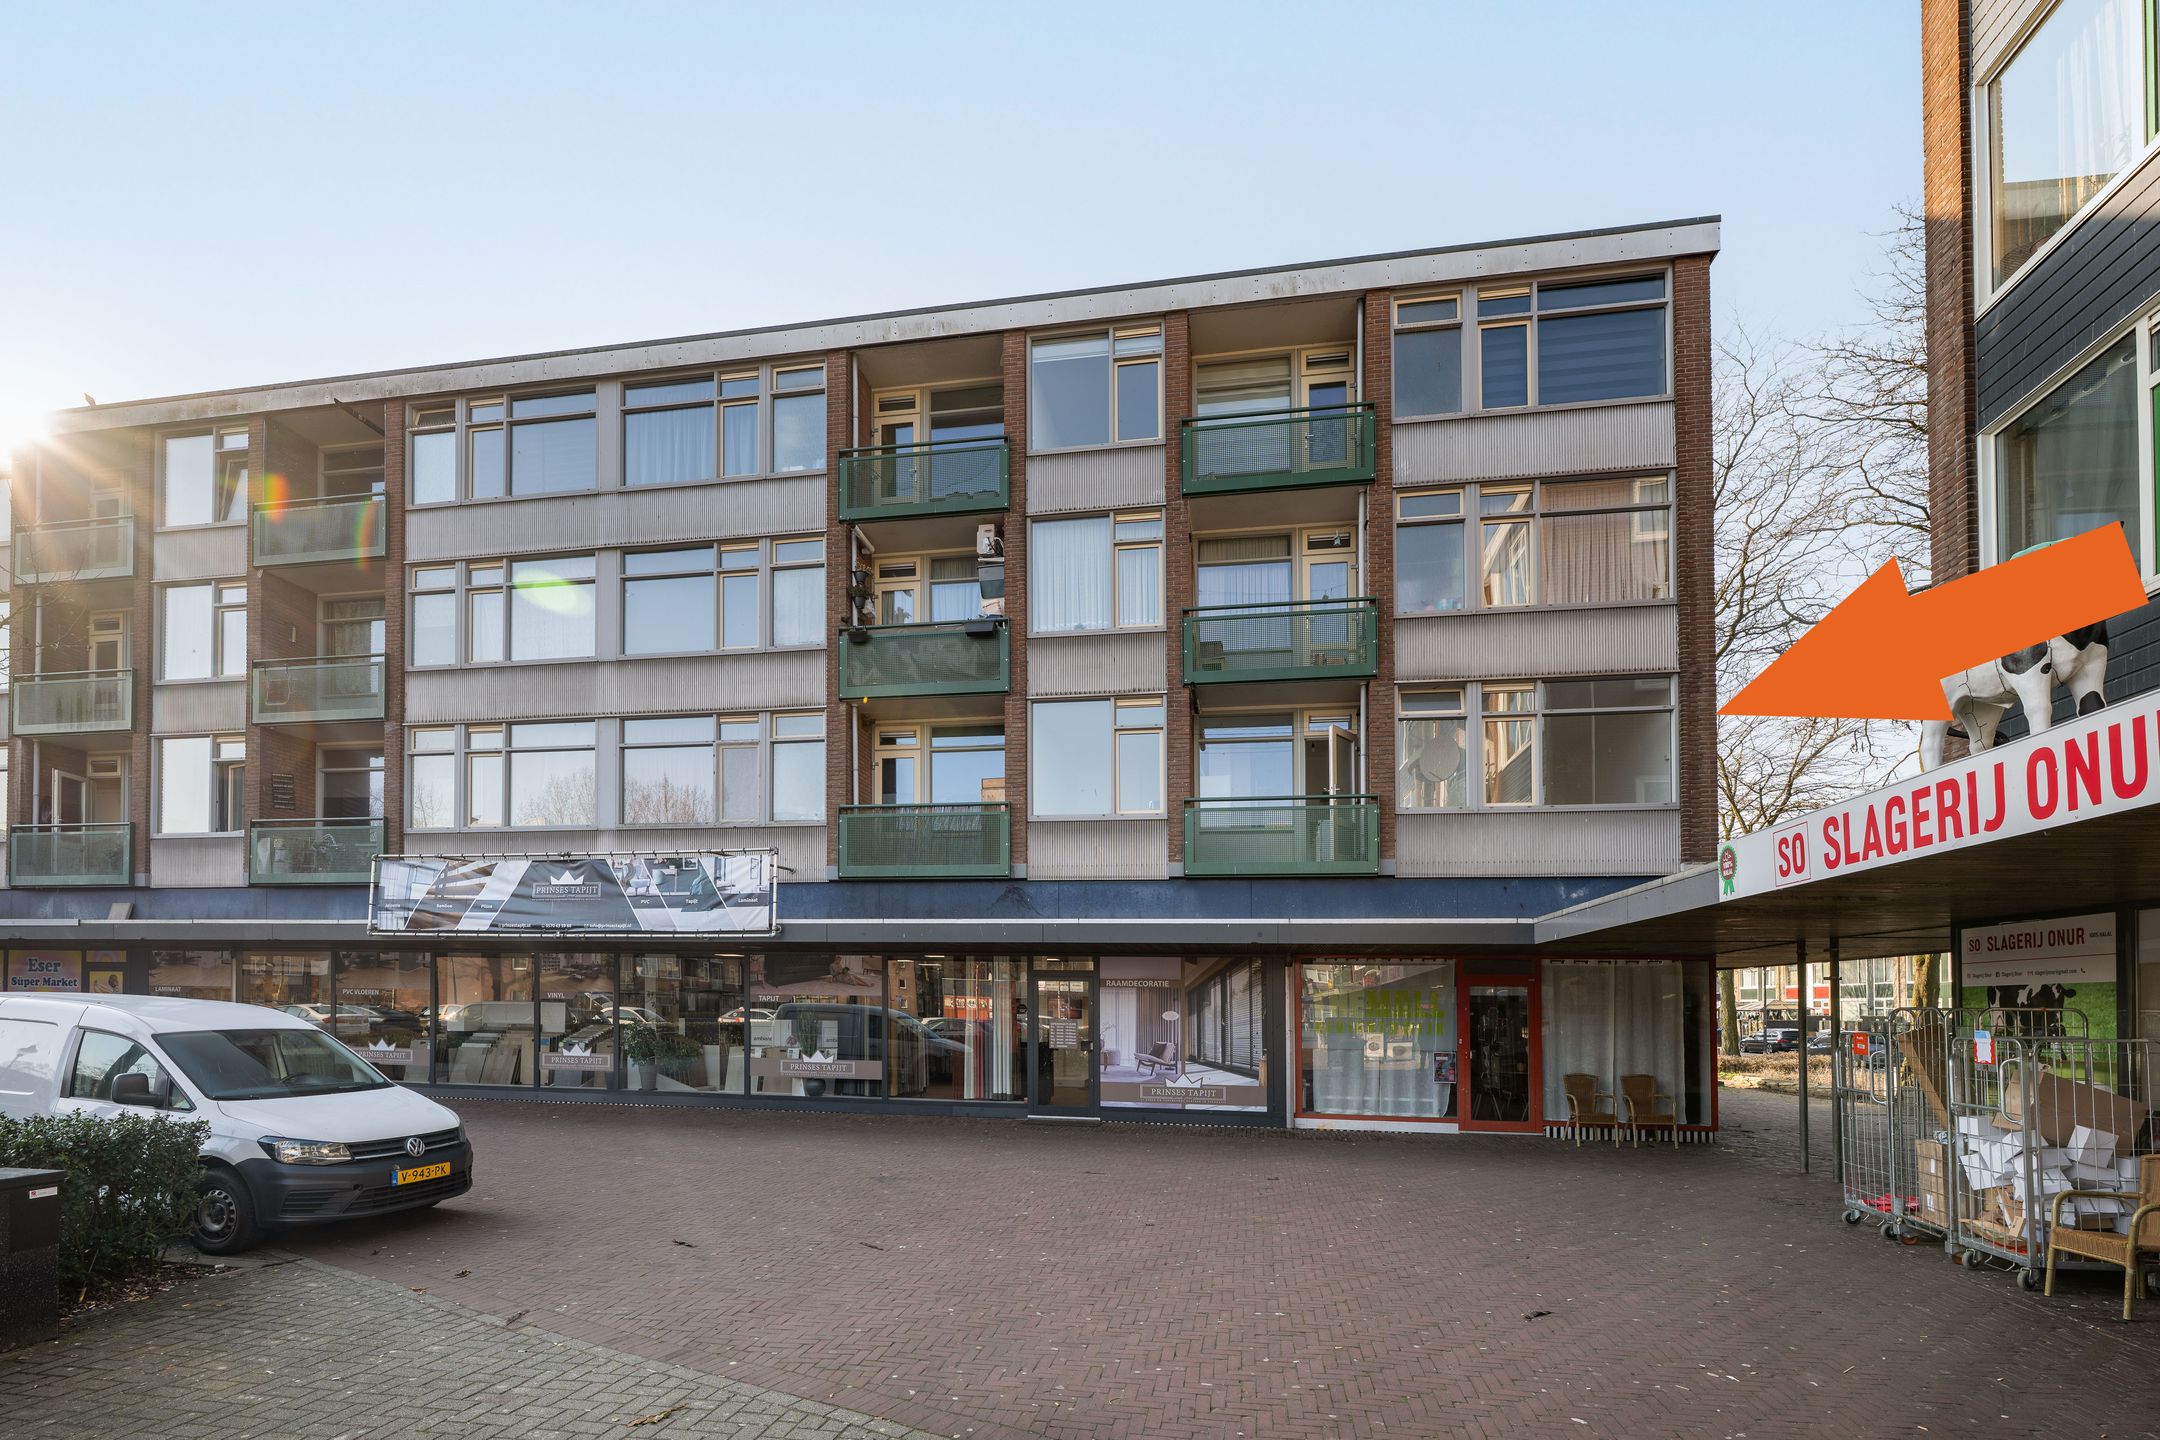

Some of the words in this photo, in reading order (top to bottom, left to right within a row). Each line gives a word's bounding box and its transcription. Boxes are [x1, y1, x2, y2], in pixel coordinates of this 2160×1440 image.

[1778, 832, 1806, 878] SO
[1822, 762, 2007, 870] SLAGERIJ
[2026, 709, 2160, 821] ONU
[536, 886, 568, 894] PRINSES
[570, 886, 598, 894] TAPIJT
[1968, 938, 1981, 952] SO
[1987, 932, 2044, 952] SLAGERIJ
[2048, 928, 2085, 947] ONUR
[28, 958, 61, 972] Eser
[12, 976, 42, 988] Süper
[42, 976, 78, 988] Market
[1188, 1089, 1216, 1097] TAPIJT
[402, 1165, 446, 1182] V-943-PK
